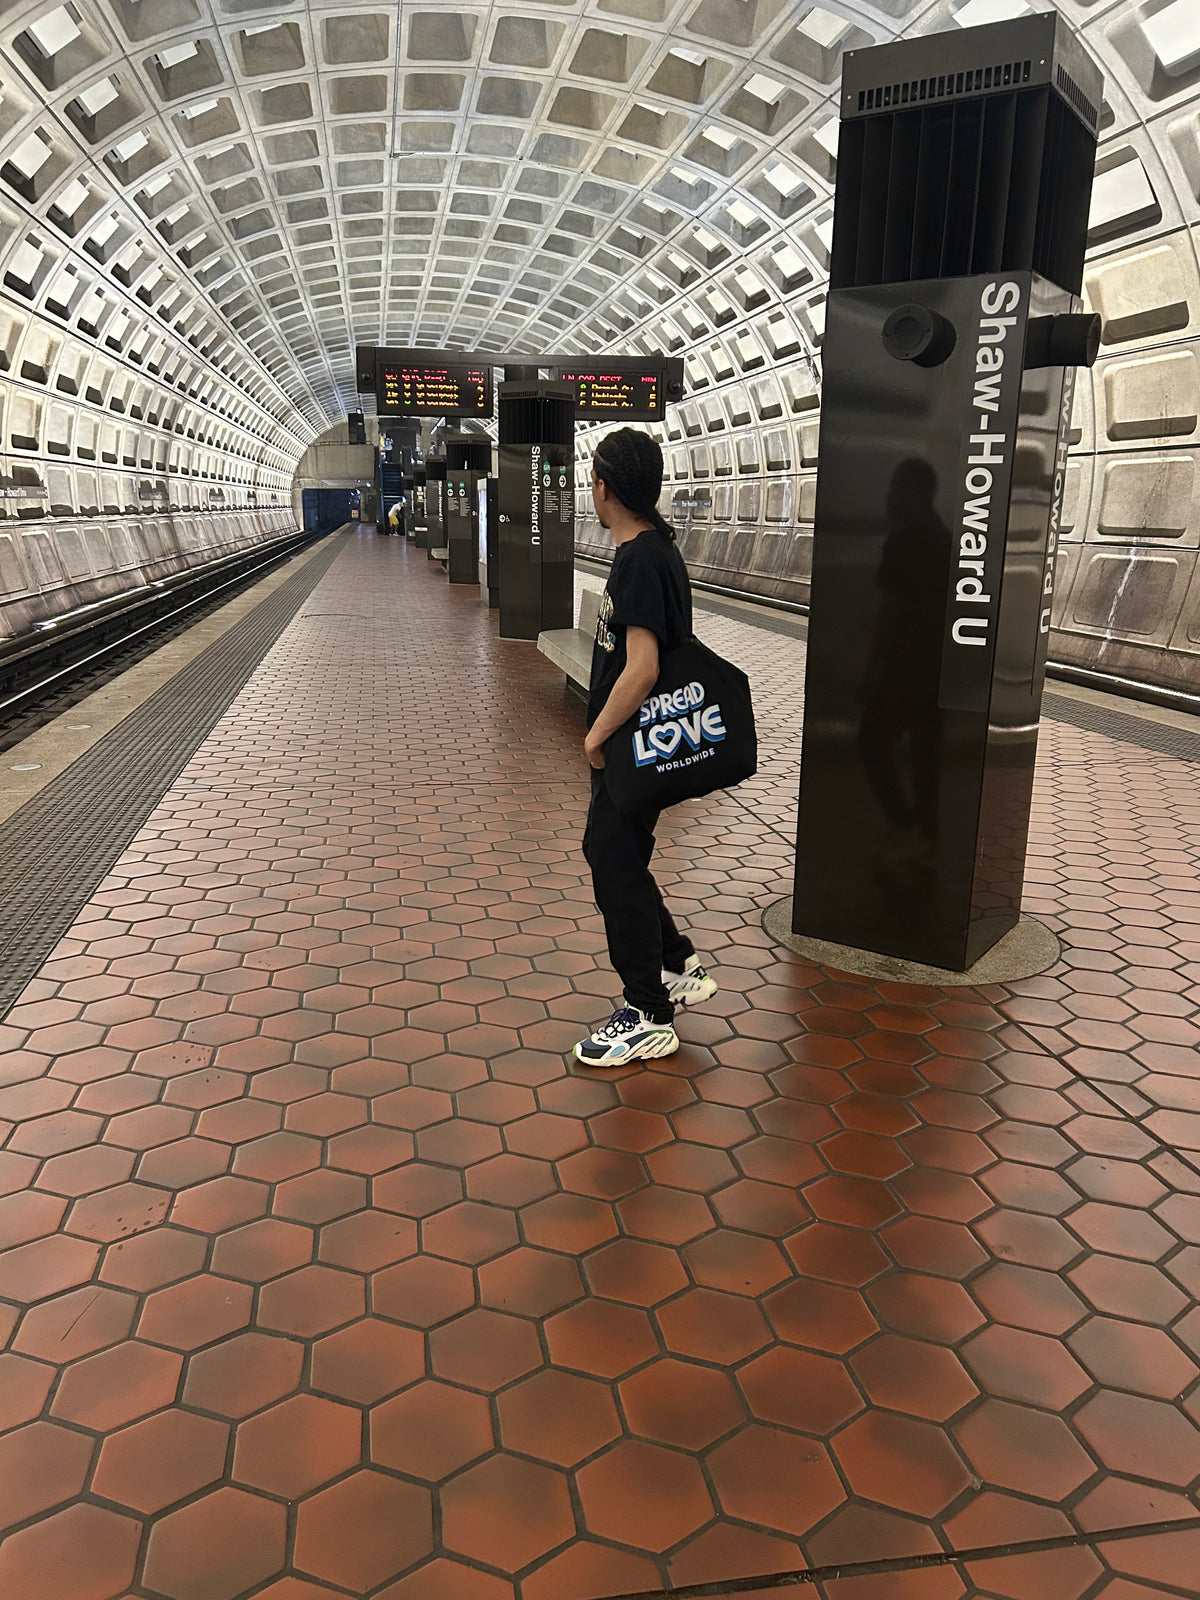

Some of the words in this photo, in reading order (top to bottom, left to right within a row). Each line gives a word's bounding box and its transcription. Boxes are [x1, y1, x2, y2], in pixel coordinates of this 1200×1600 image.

[955, 281, 1021, 602] Shaw-Howard
[1043, 303, 1082, 595] aw-Howard
[531, 445, 541, 533] Shaw-Howard
[531, 536, 541, 545] U
[951, 617, 989, 646] U
[1039, 608, 1051, 634] U
[638, 681, 705, 726] SPREAD
[631, 703, 727, 767] LOVE
[655, 747, 716, 773] WORLDWIDE
